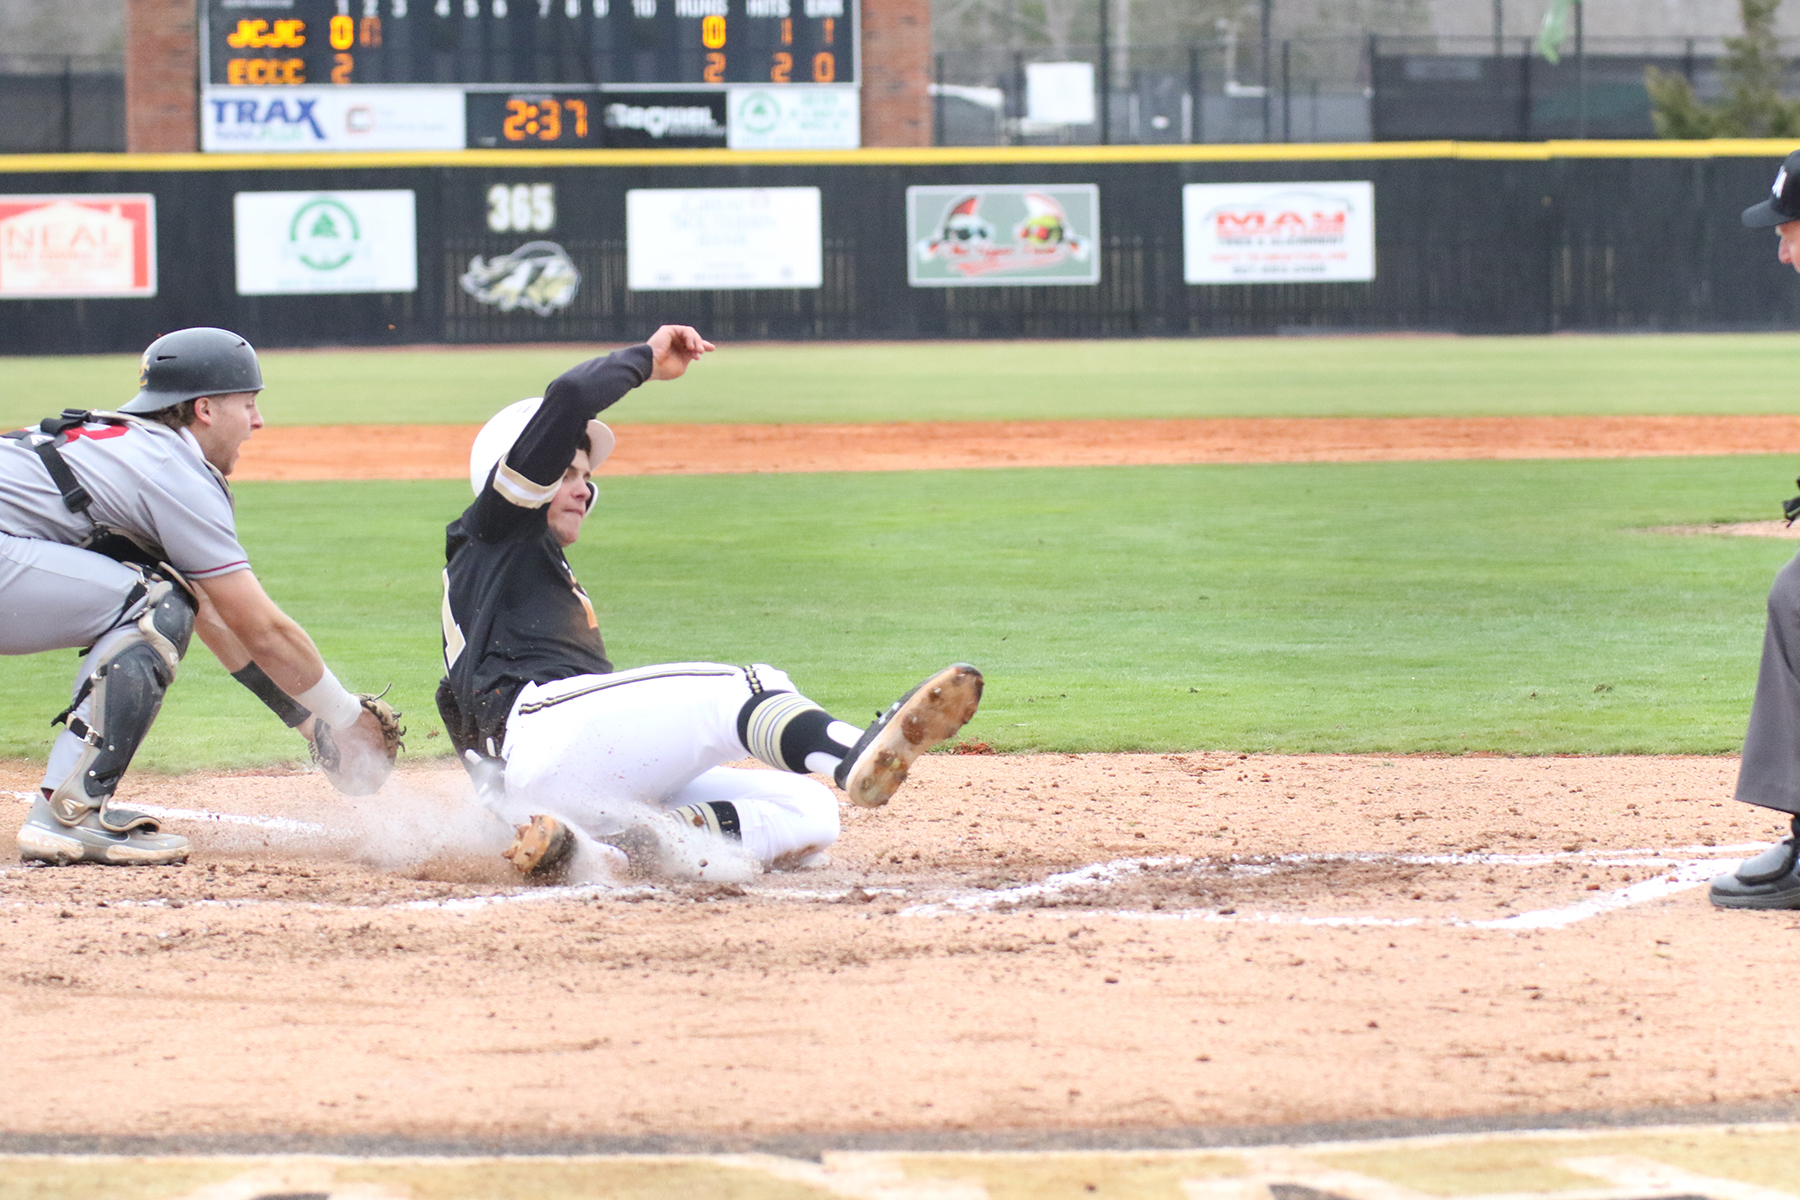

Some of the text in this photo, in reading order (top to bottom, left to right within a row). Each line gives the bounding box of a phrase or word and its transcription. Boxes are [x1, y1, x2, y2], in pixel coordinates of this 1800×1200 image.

[227, 19, 306, 48] JCJC
[329, 14, 354, 50] 0
[702, 14, 727, 49] 0
[330, 53, 354, 84] 2
[703, 52, 726, 83] 2
[770, 52, 793, 83] 2
[812, 52, 835, 83] 0
[211, 99, 326, 141] TRAX
[503, 99, 588, 141] 2:37
[487, 184, 555, 232] 365
